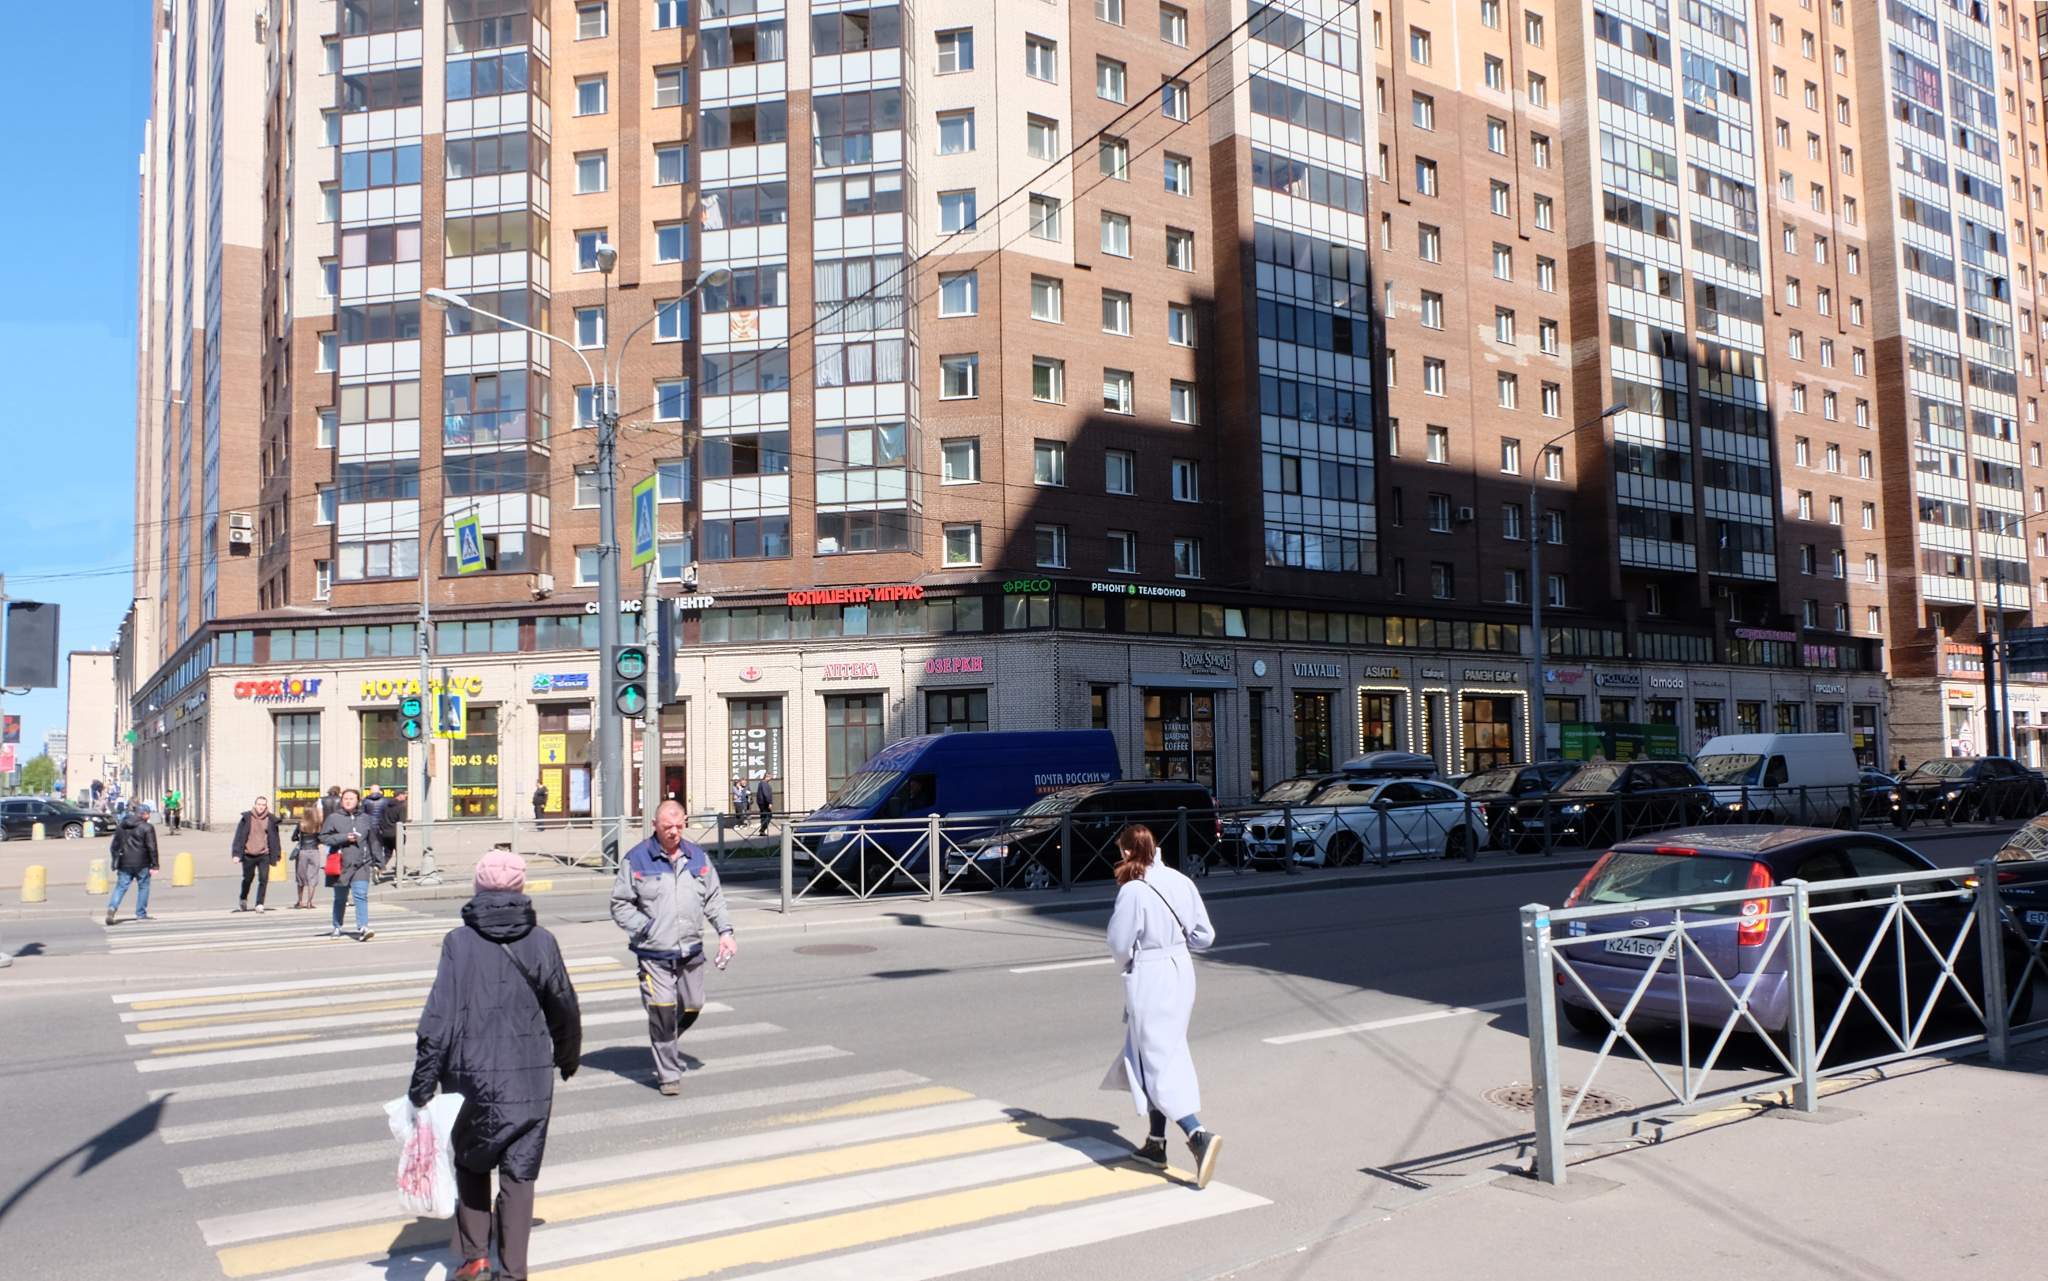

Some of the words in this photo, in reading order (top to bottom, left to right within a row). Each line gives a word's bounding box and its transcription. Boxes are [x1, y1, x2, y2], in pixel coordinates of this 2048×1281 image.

[787, 588, 872, 606] КОПИЦЕНТР
[873, 586, 924, 601] ИПРИС
[1091, 582, 1125, 594] РЕМОНТ
[1137, 585, 1187, 598] ТЕЛЕФОНОВ
[584, 599, 642, 615] СИС
[823, 662, 879, 679] АПТЕКА
[924, 656, 984, 674] ОЗЕРКИ
[360, 675, 482, 699] НОТАУС
[1650, 676, 1684, 688] lamoda
[747, 728, 767, 779] ОЧКИ
[1034, 773, 1063, 785] ПОЧТА
[1066, 772, 1100, 784] РОССИИ
